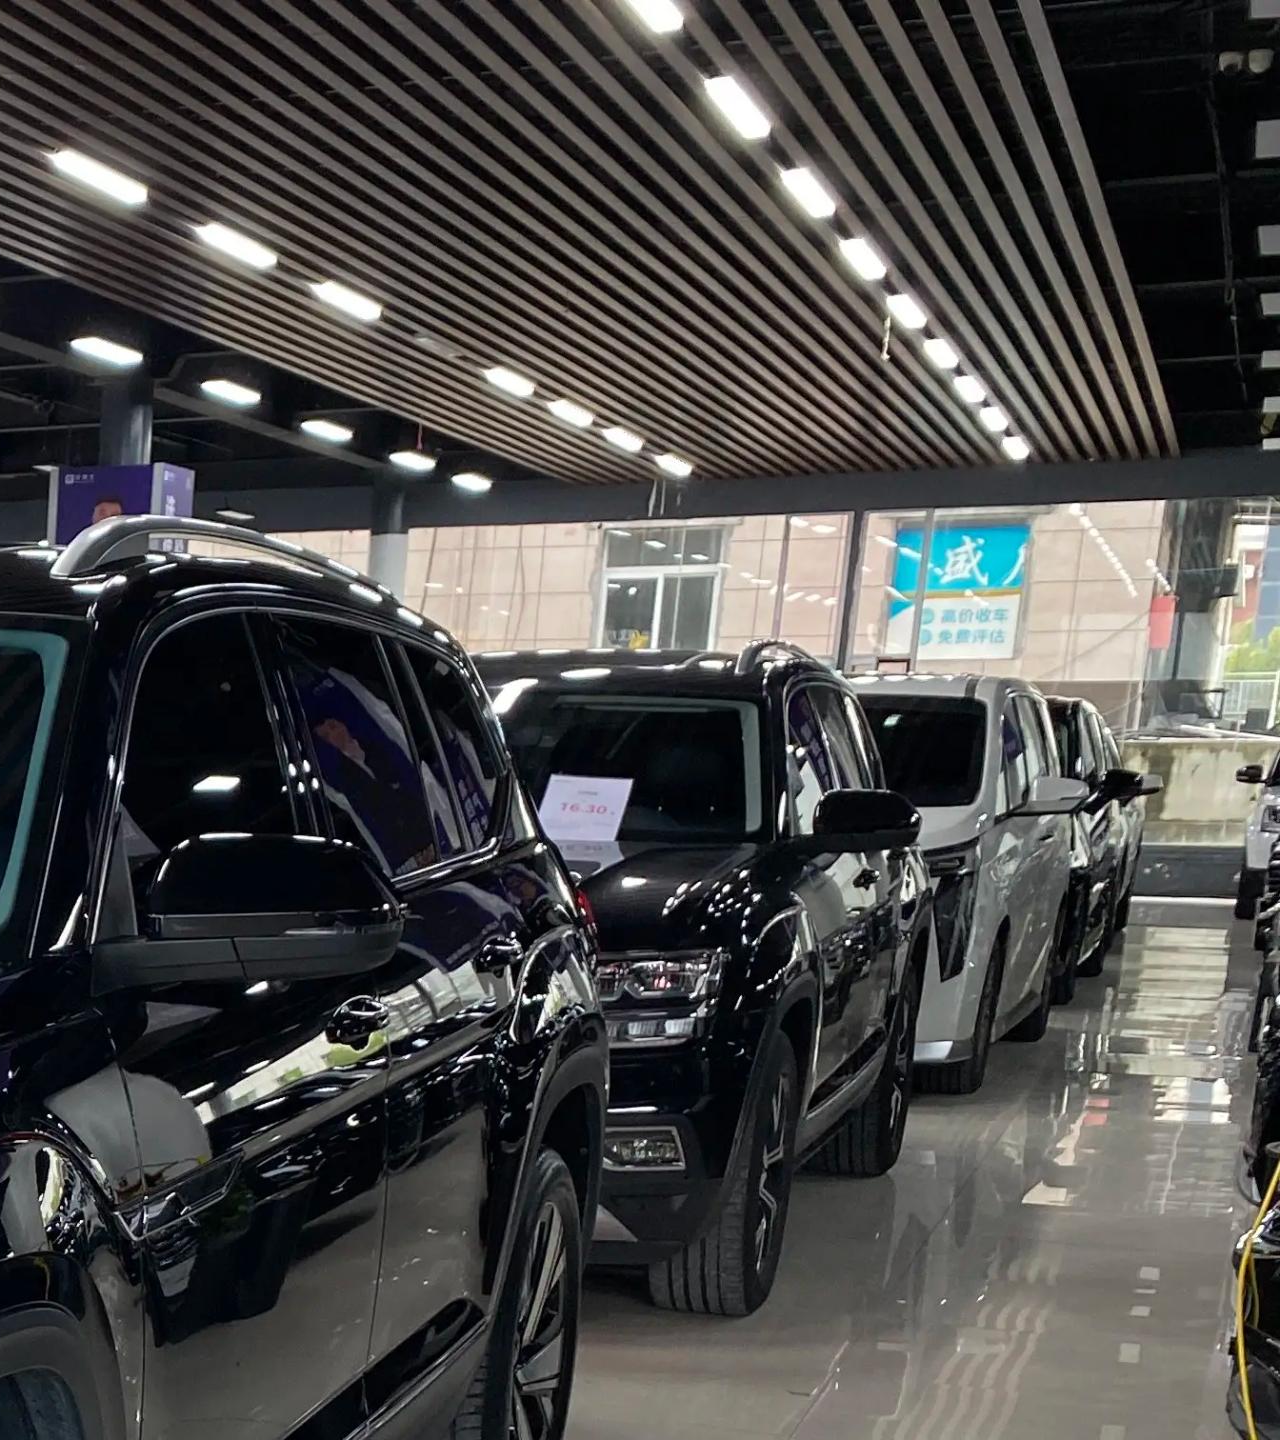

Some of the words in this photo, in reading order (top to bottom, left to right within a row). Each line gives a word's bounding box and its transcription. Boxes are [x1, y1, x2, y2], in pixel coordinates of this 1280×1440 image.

[940, 608, 1009, 624] 高价收车
[937, 628, 1006, 645] 免费评估
